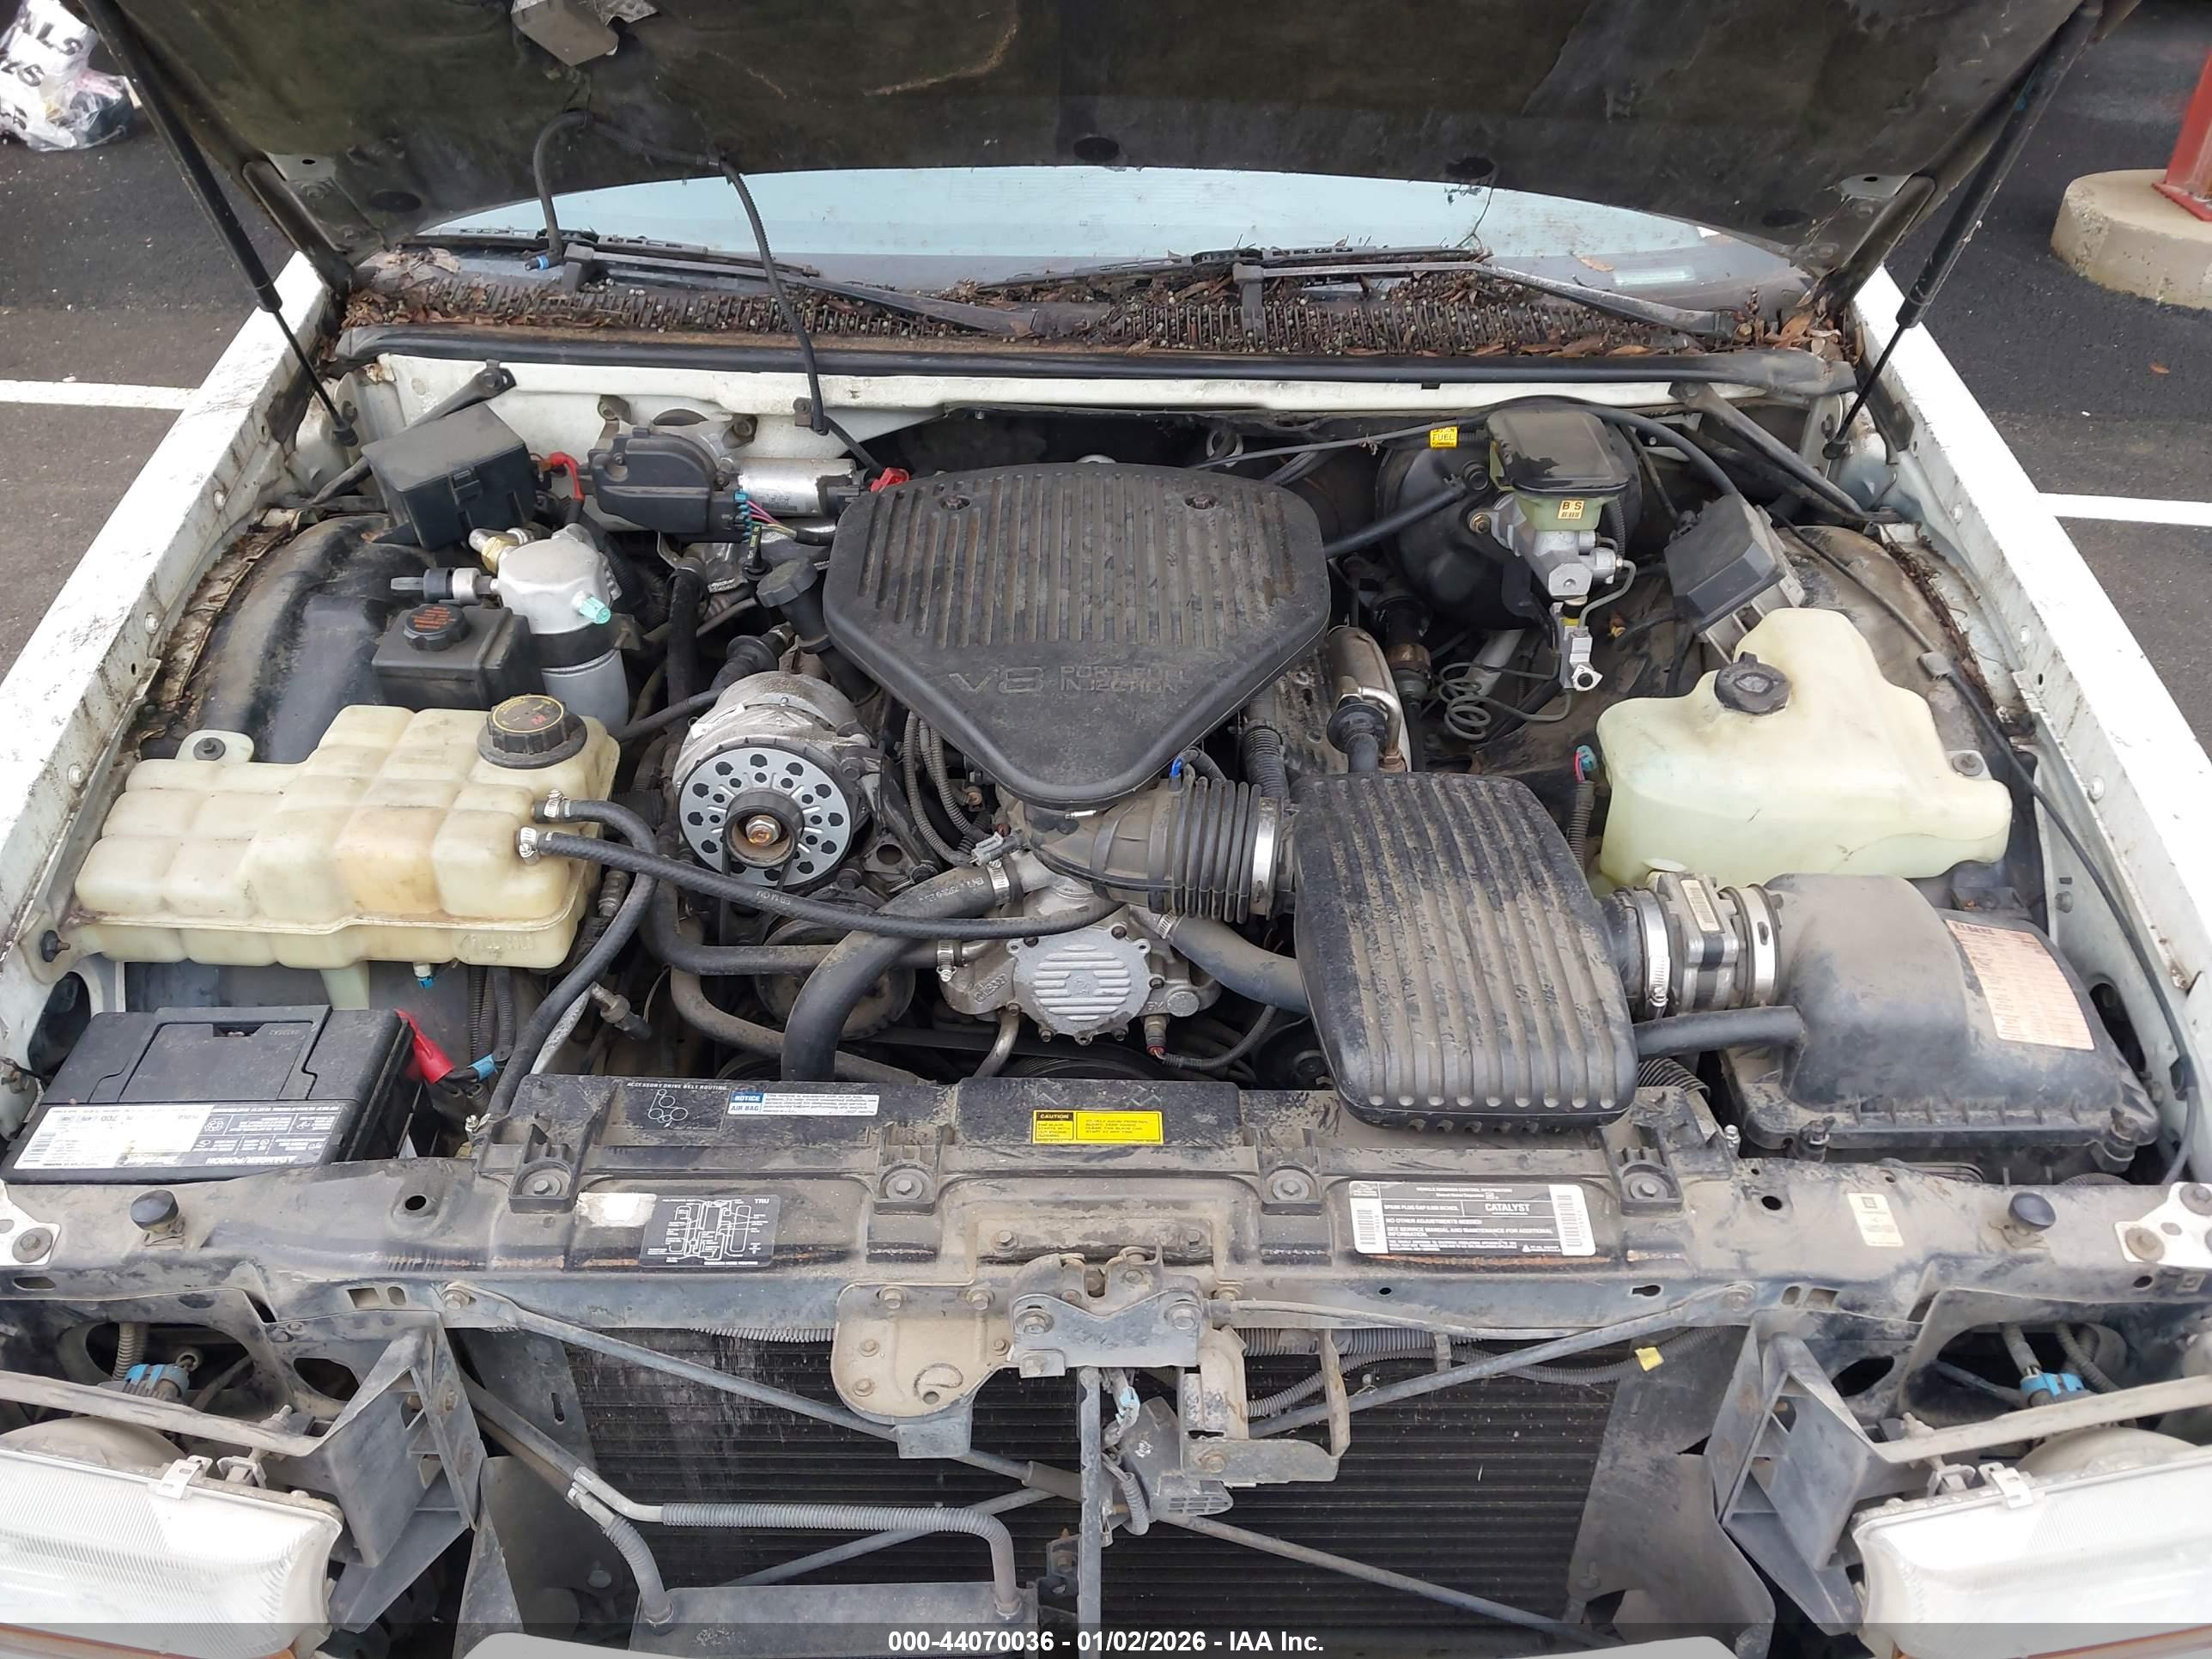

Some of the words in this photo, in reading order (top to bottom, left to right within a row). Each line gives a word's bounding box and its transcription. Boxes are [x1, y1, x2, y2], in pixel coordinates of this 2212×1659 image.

[1562, 501, 1570, 510] B
[1574, 501, 1582, 510] S
[948, 666, 1044, 694] V8
[1485, 1203, 1530, 1212] CATALYST
